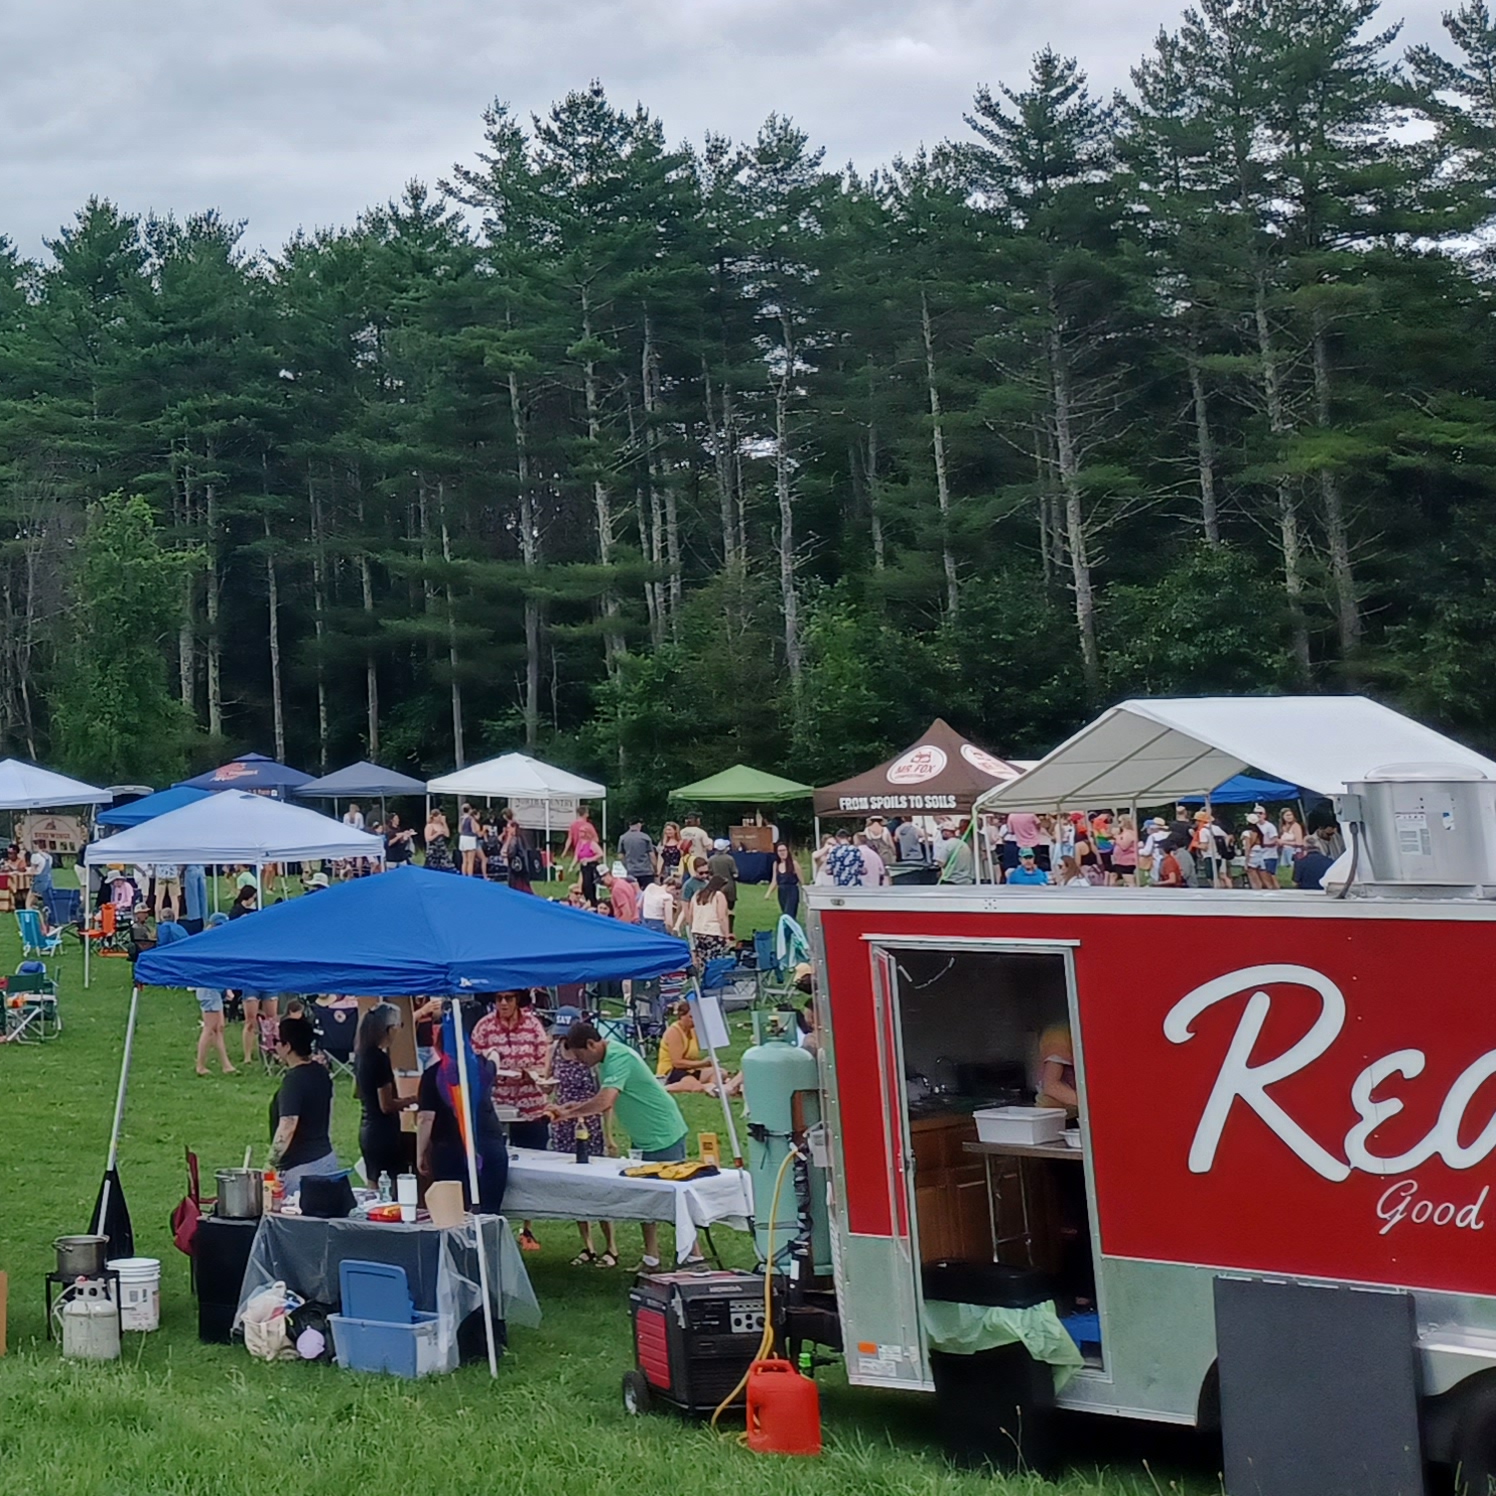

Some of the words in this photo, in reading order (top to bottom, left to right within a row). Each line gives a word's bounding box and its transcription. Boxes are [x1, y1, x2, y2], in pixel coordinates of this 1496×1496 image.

[914, 764, 936, 774] FOX
[839, 796, 869, 810] FROM
[870, 795, 907, 810] SPOILS
[909, 795, 923, 809] TO
[924, 794, 957, 809] SOILS
[1376, 1179, 1490, 1235] Good
